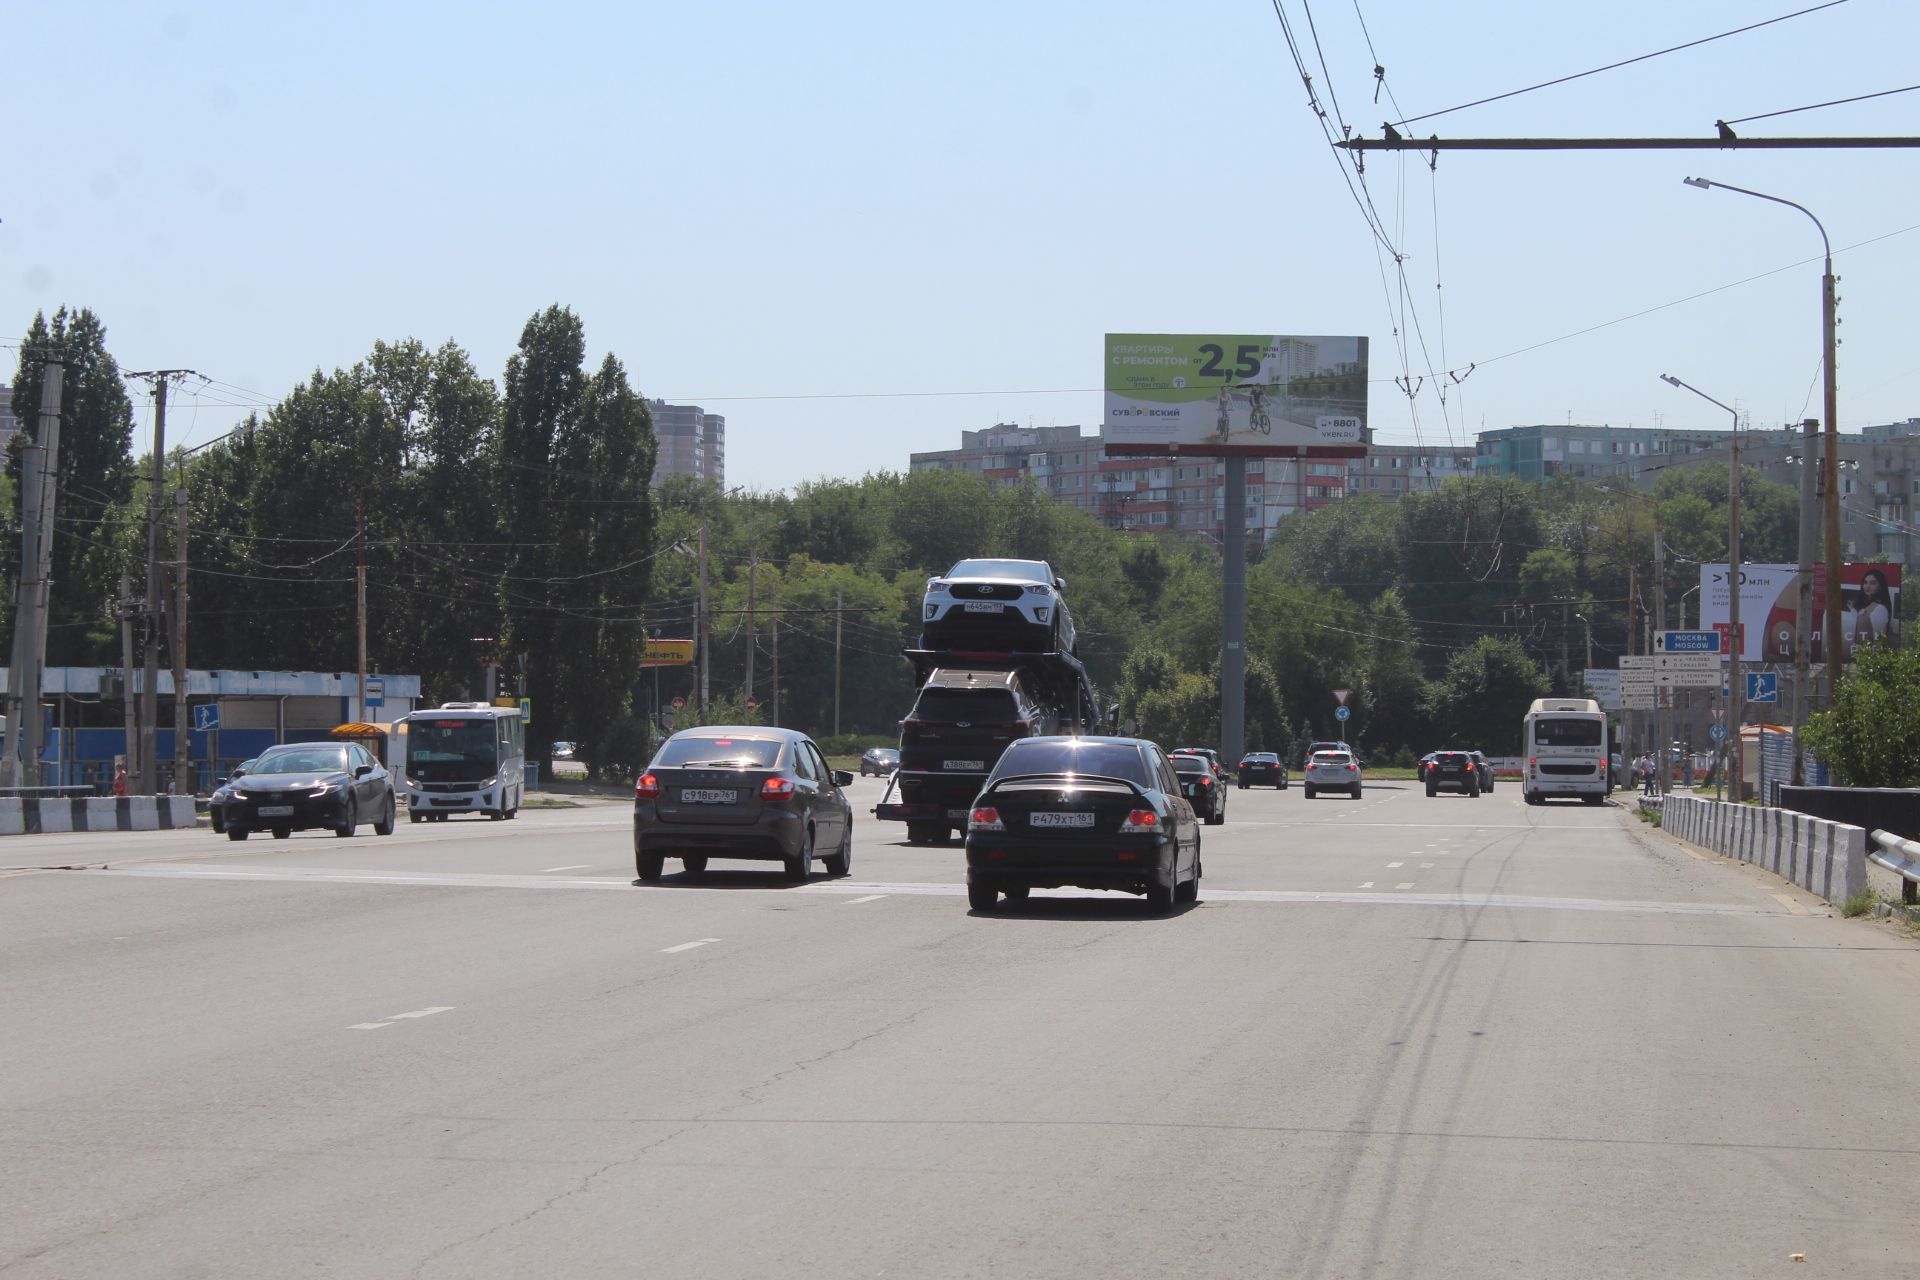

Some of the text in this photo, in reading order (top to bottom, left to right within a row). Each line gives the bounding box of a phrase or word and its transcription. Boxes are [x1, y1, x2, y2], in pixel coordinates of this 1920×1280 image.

[1112, 344, 1175, 355] КВАРТИРЫ
[1112, 356, 1121, 366] С
[1123, 356, 1188, 366] РЕМОНТОМ
[1198, 343, 1261, 384] 2,5
[1674, 634, 1708, 642] МОСКВА
[1033, 813, 1075, 825] Р479ХТ
